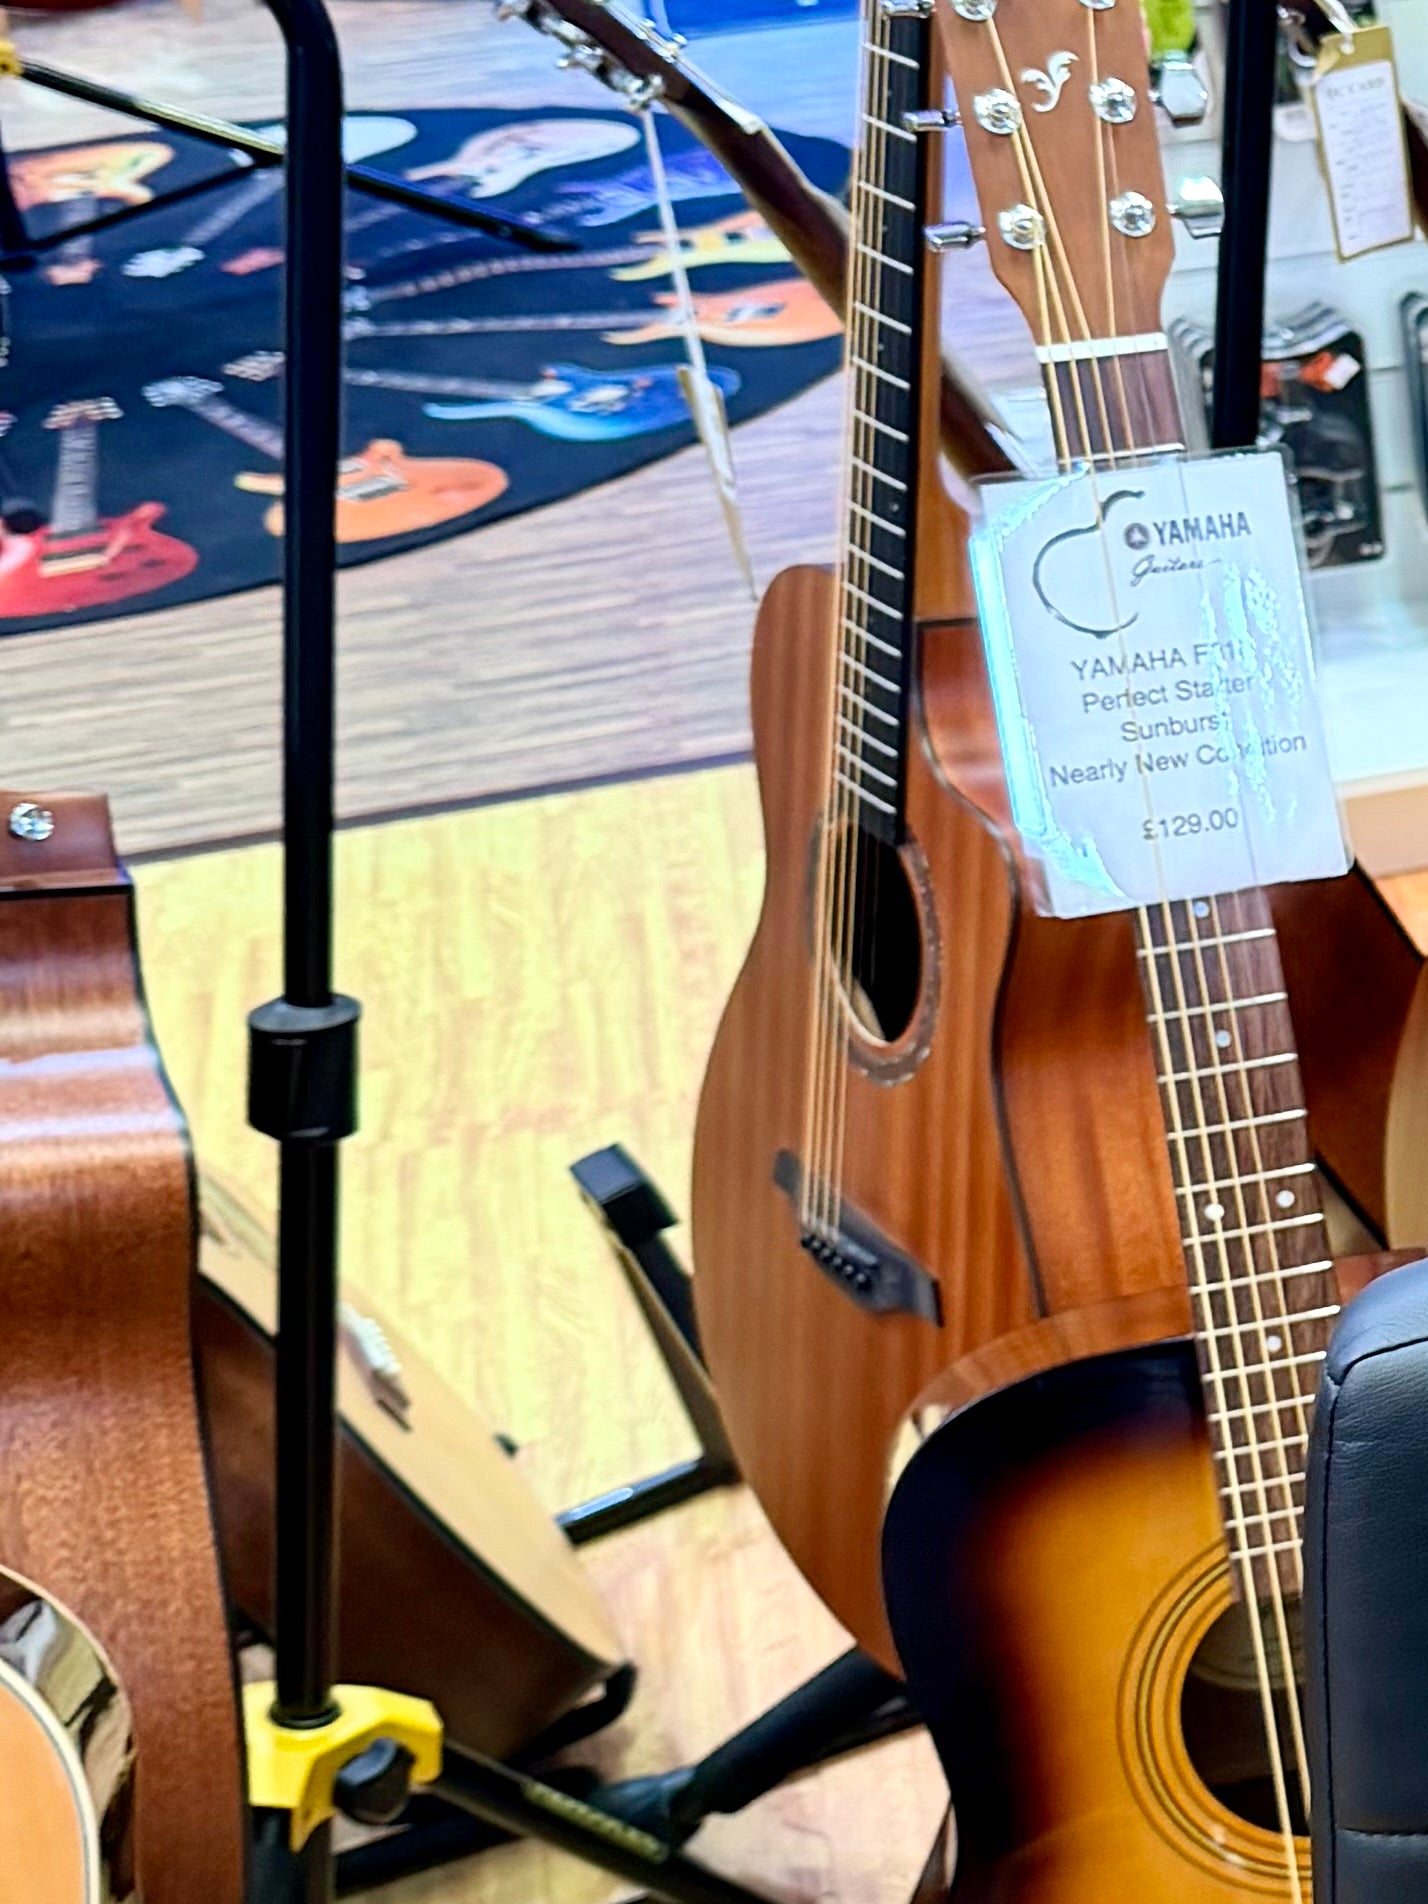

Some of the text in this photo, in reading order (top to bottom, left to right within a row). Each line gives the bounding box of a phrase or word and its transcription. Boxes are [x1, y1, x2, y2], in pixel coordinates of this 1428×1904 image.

[1152, 511, 1253, 546] YAMAHA
[1070, 646, 1187, 681] YAMAHA
[1081, 675, 1254, 713] Perfect Stater
[1049, 758, 1128, 788] Nearly
[1134, 752, 1189, 775] New
[1141, 807, 1239, 841] £129.00
